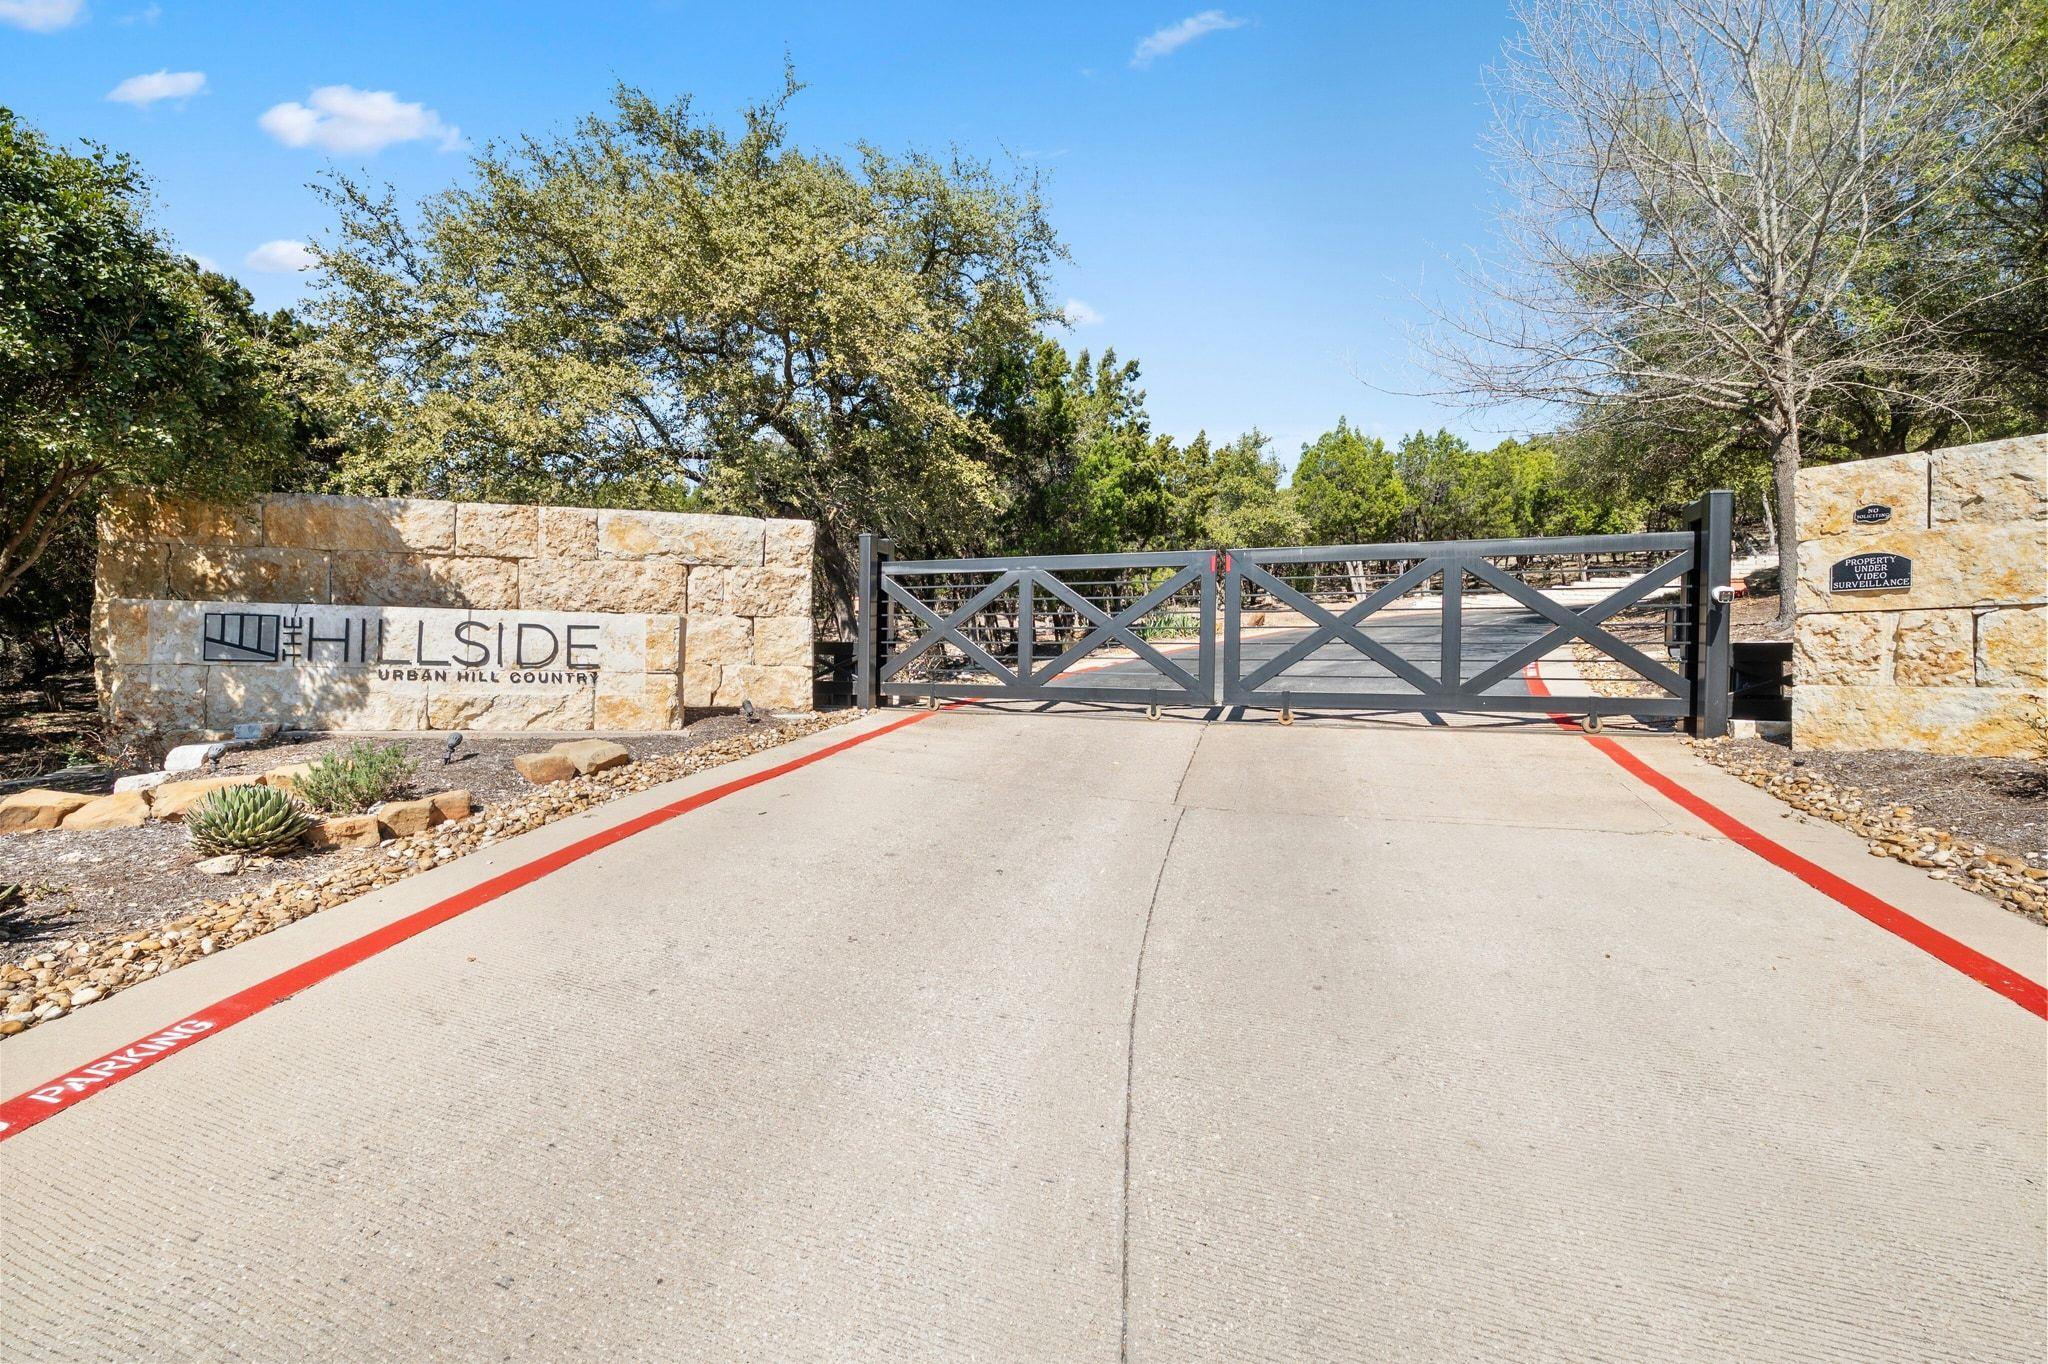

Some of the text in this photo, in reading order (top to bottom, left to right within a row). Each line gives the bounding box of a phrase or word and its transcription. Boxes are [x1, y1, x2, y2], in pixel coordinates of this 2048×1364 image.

[1845, 556, 1897, 566] PROPERTY
[1854, 564, 1888, 572] UNDER
[1855, 572, 1887, 580] VIDEO
[1833, 578, 1910, 588] SURVEILLANCE
[282, 616, 600, 670] THE HILLSIDE
[378, 669, 600, 685] URBAN HILL COUNTRY
[28, 1020, 214, 1104] PARKING
